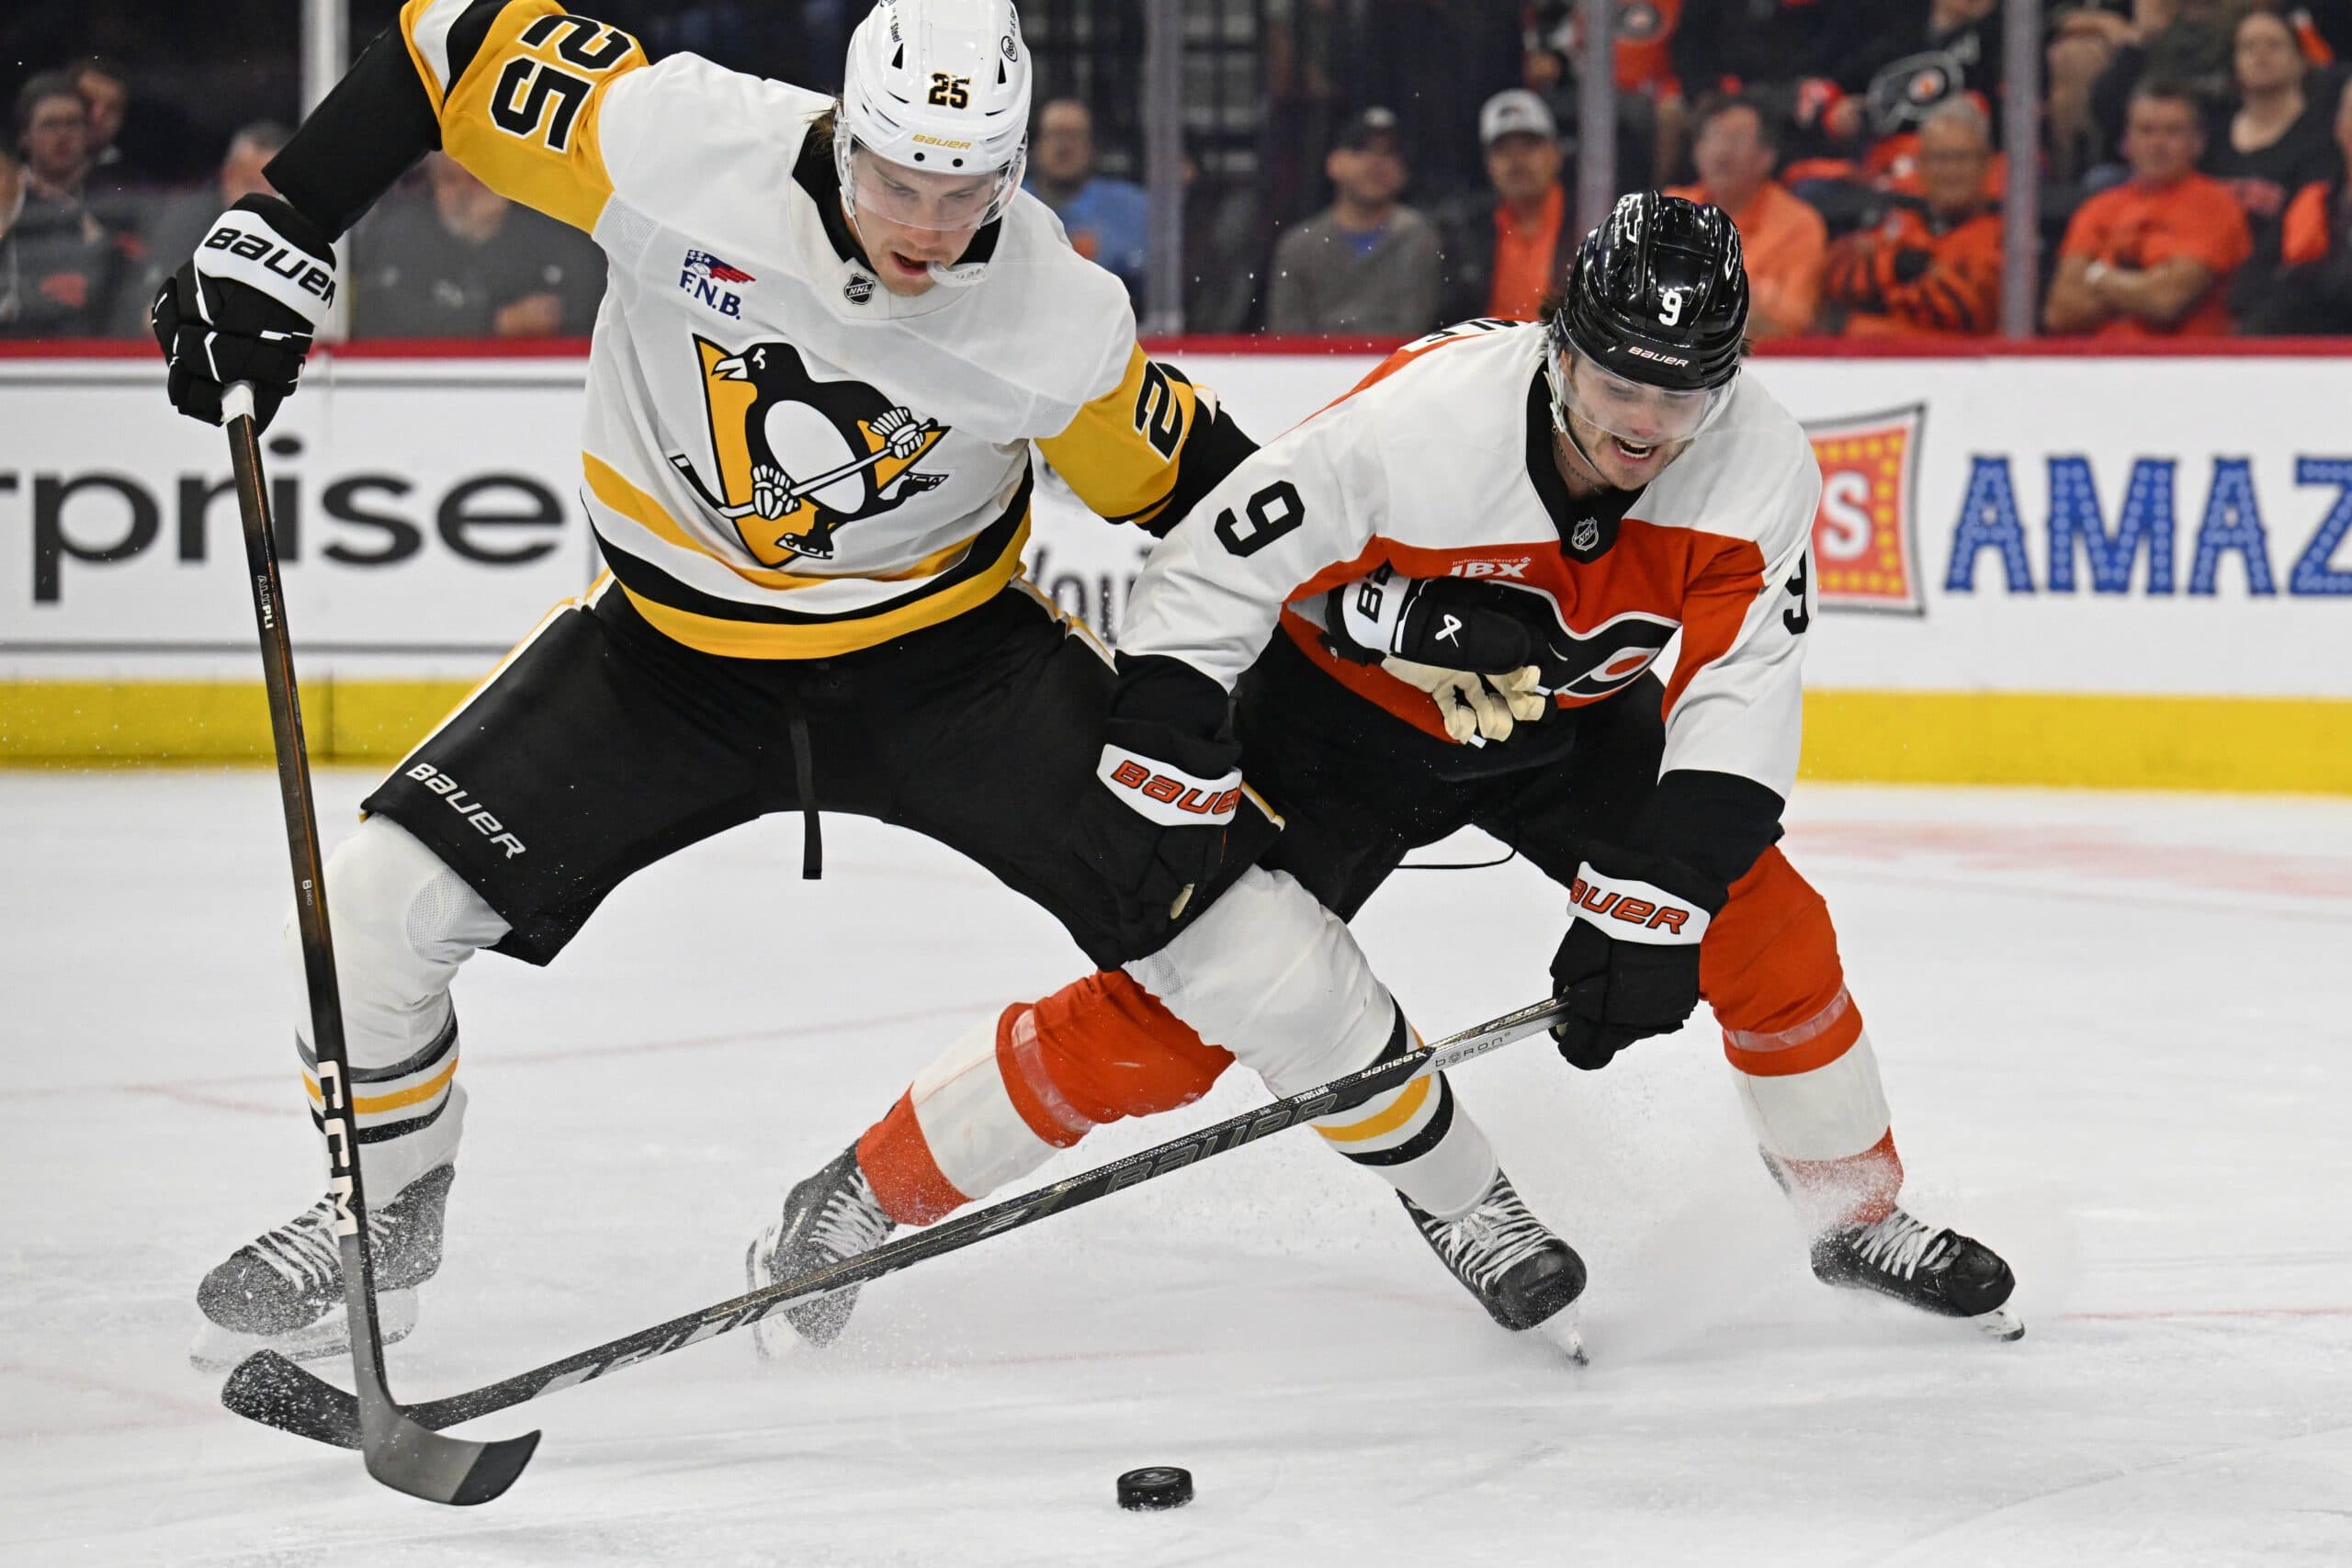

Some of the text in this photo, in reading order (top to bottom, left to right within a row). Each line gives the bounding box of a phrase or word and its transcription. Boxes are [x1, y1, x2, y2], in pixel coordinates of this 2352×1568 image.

[488, 13, 635, 154] 25
[928, 73, 970, 109] 25
[679, 269, 741, 320] F.N.B.
[848, 285, 871, 296] NHL
[1658, 288, 1682, 326] 9
[0, 435, 567, 602] prise
[1577, 526, 1595, 545] NHL
[1943, 455, 2352, 596] AMAZ
[1449, 562, 1530, 578] IBX
[1570, 877, 1690, 935] AUER
[317, 1060, 359, 1236] CCM
